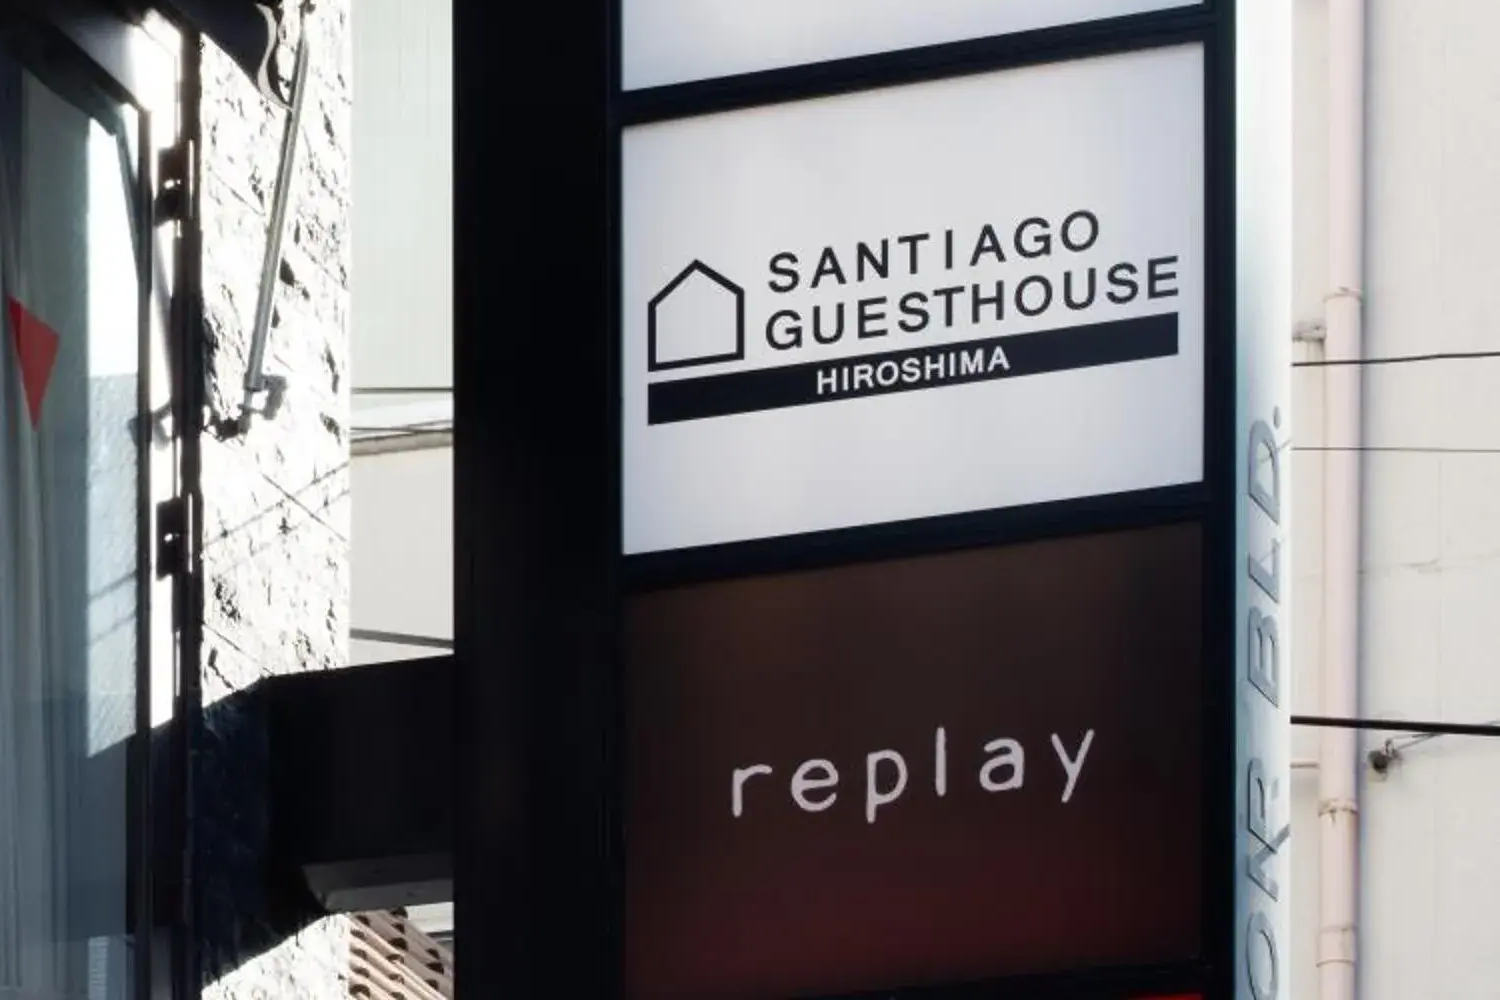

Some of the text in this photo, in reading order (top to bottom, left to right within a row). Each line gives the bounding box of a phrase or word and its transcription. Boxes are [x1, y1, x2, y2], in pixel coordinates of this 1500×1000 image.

[768, 210, 1099, 293] SANTIAGO
[765, 255, 1180, 351] GUESTHOUSE
[817, 346, 1011, 394] HIROSHIMA
[1247, 406, 1280, 708] BLD.
[732, 727, 1094, 823] replay
